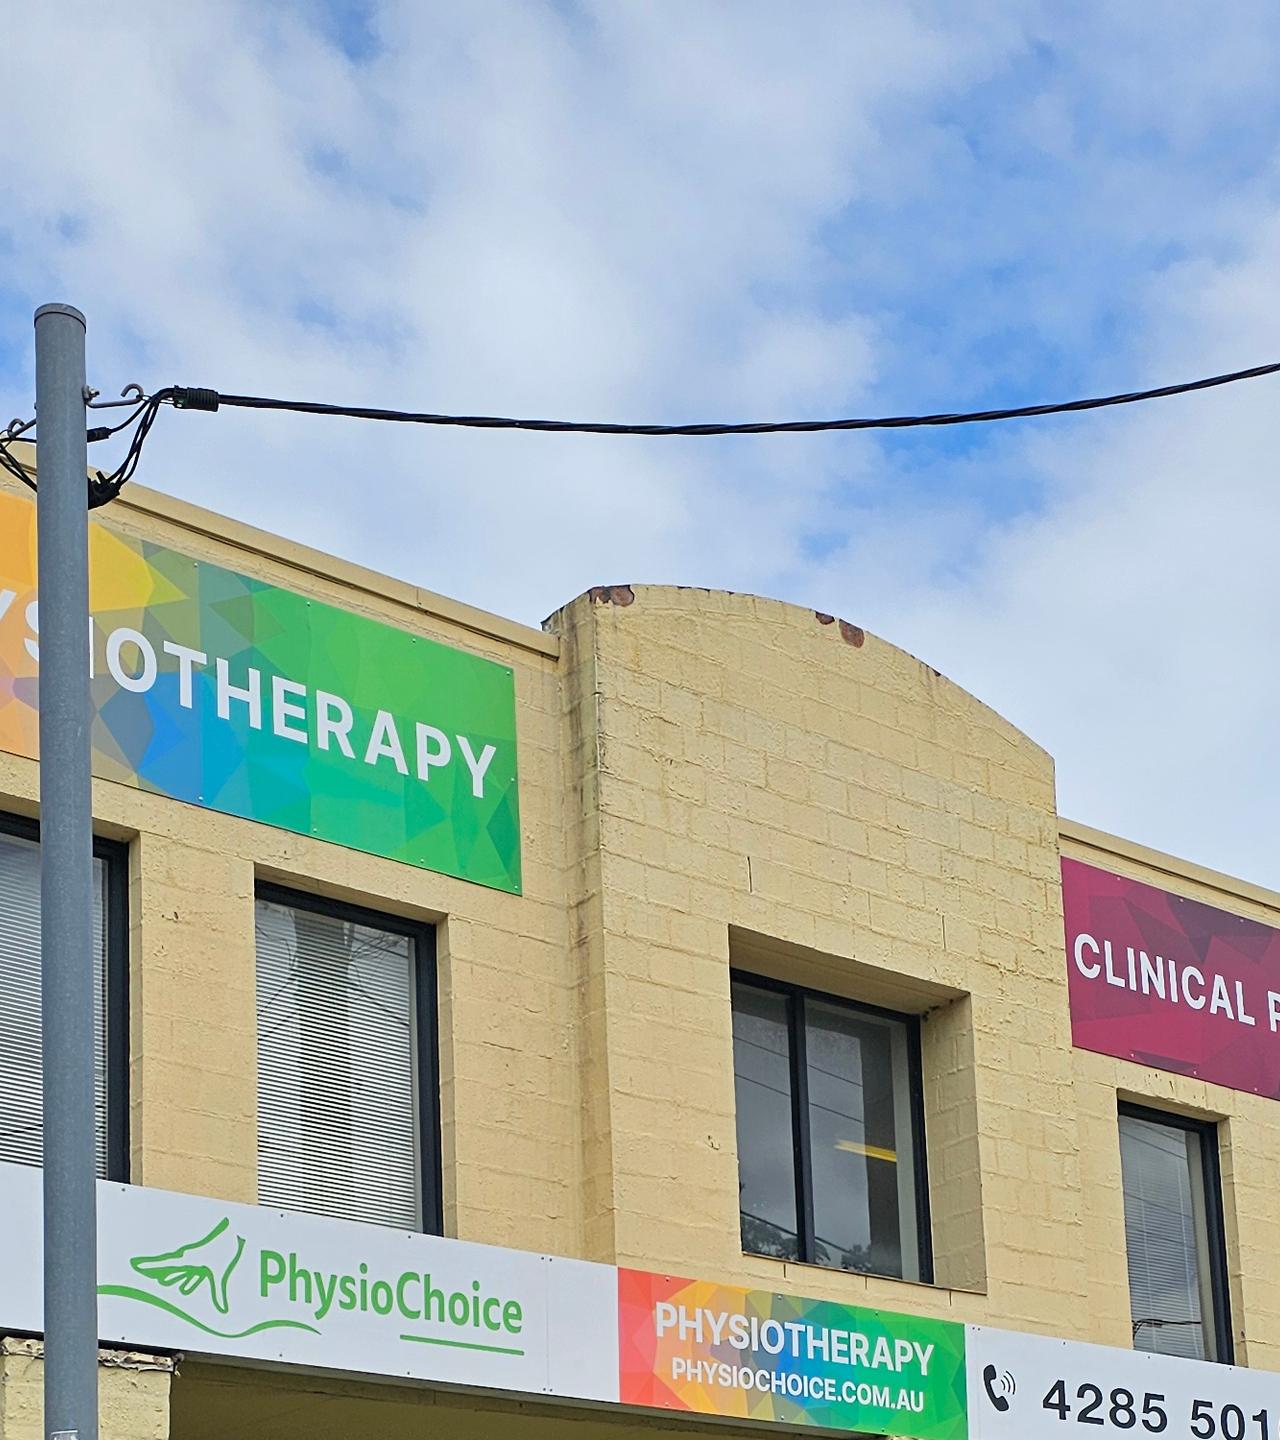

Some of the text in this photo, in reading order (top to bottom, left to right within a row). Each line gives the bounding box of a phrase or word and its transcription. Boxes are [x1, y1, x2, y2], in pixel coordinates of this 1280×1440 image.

[1074, 933, 1255, 1026] CLINICAL
[261, 1249, 523, 1334] PhysioChoice
[656, 1301, 935, 1376] PHYSIOTHERAPY
[672, 1357, 924, 1413] PHYSIOCHOICE.COM.AU
[1043, 1379, 1168, 1433] 4285
